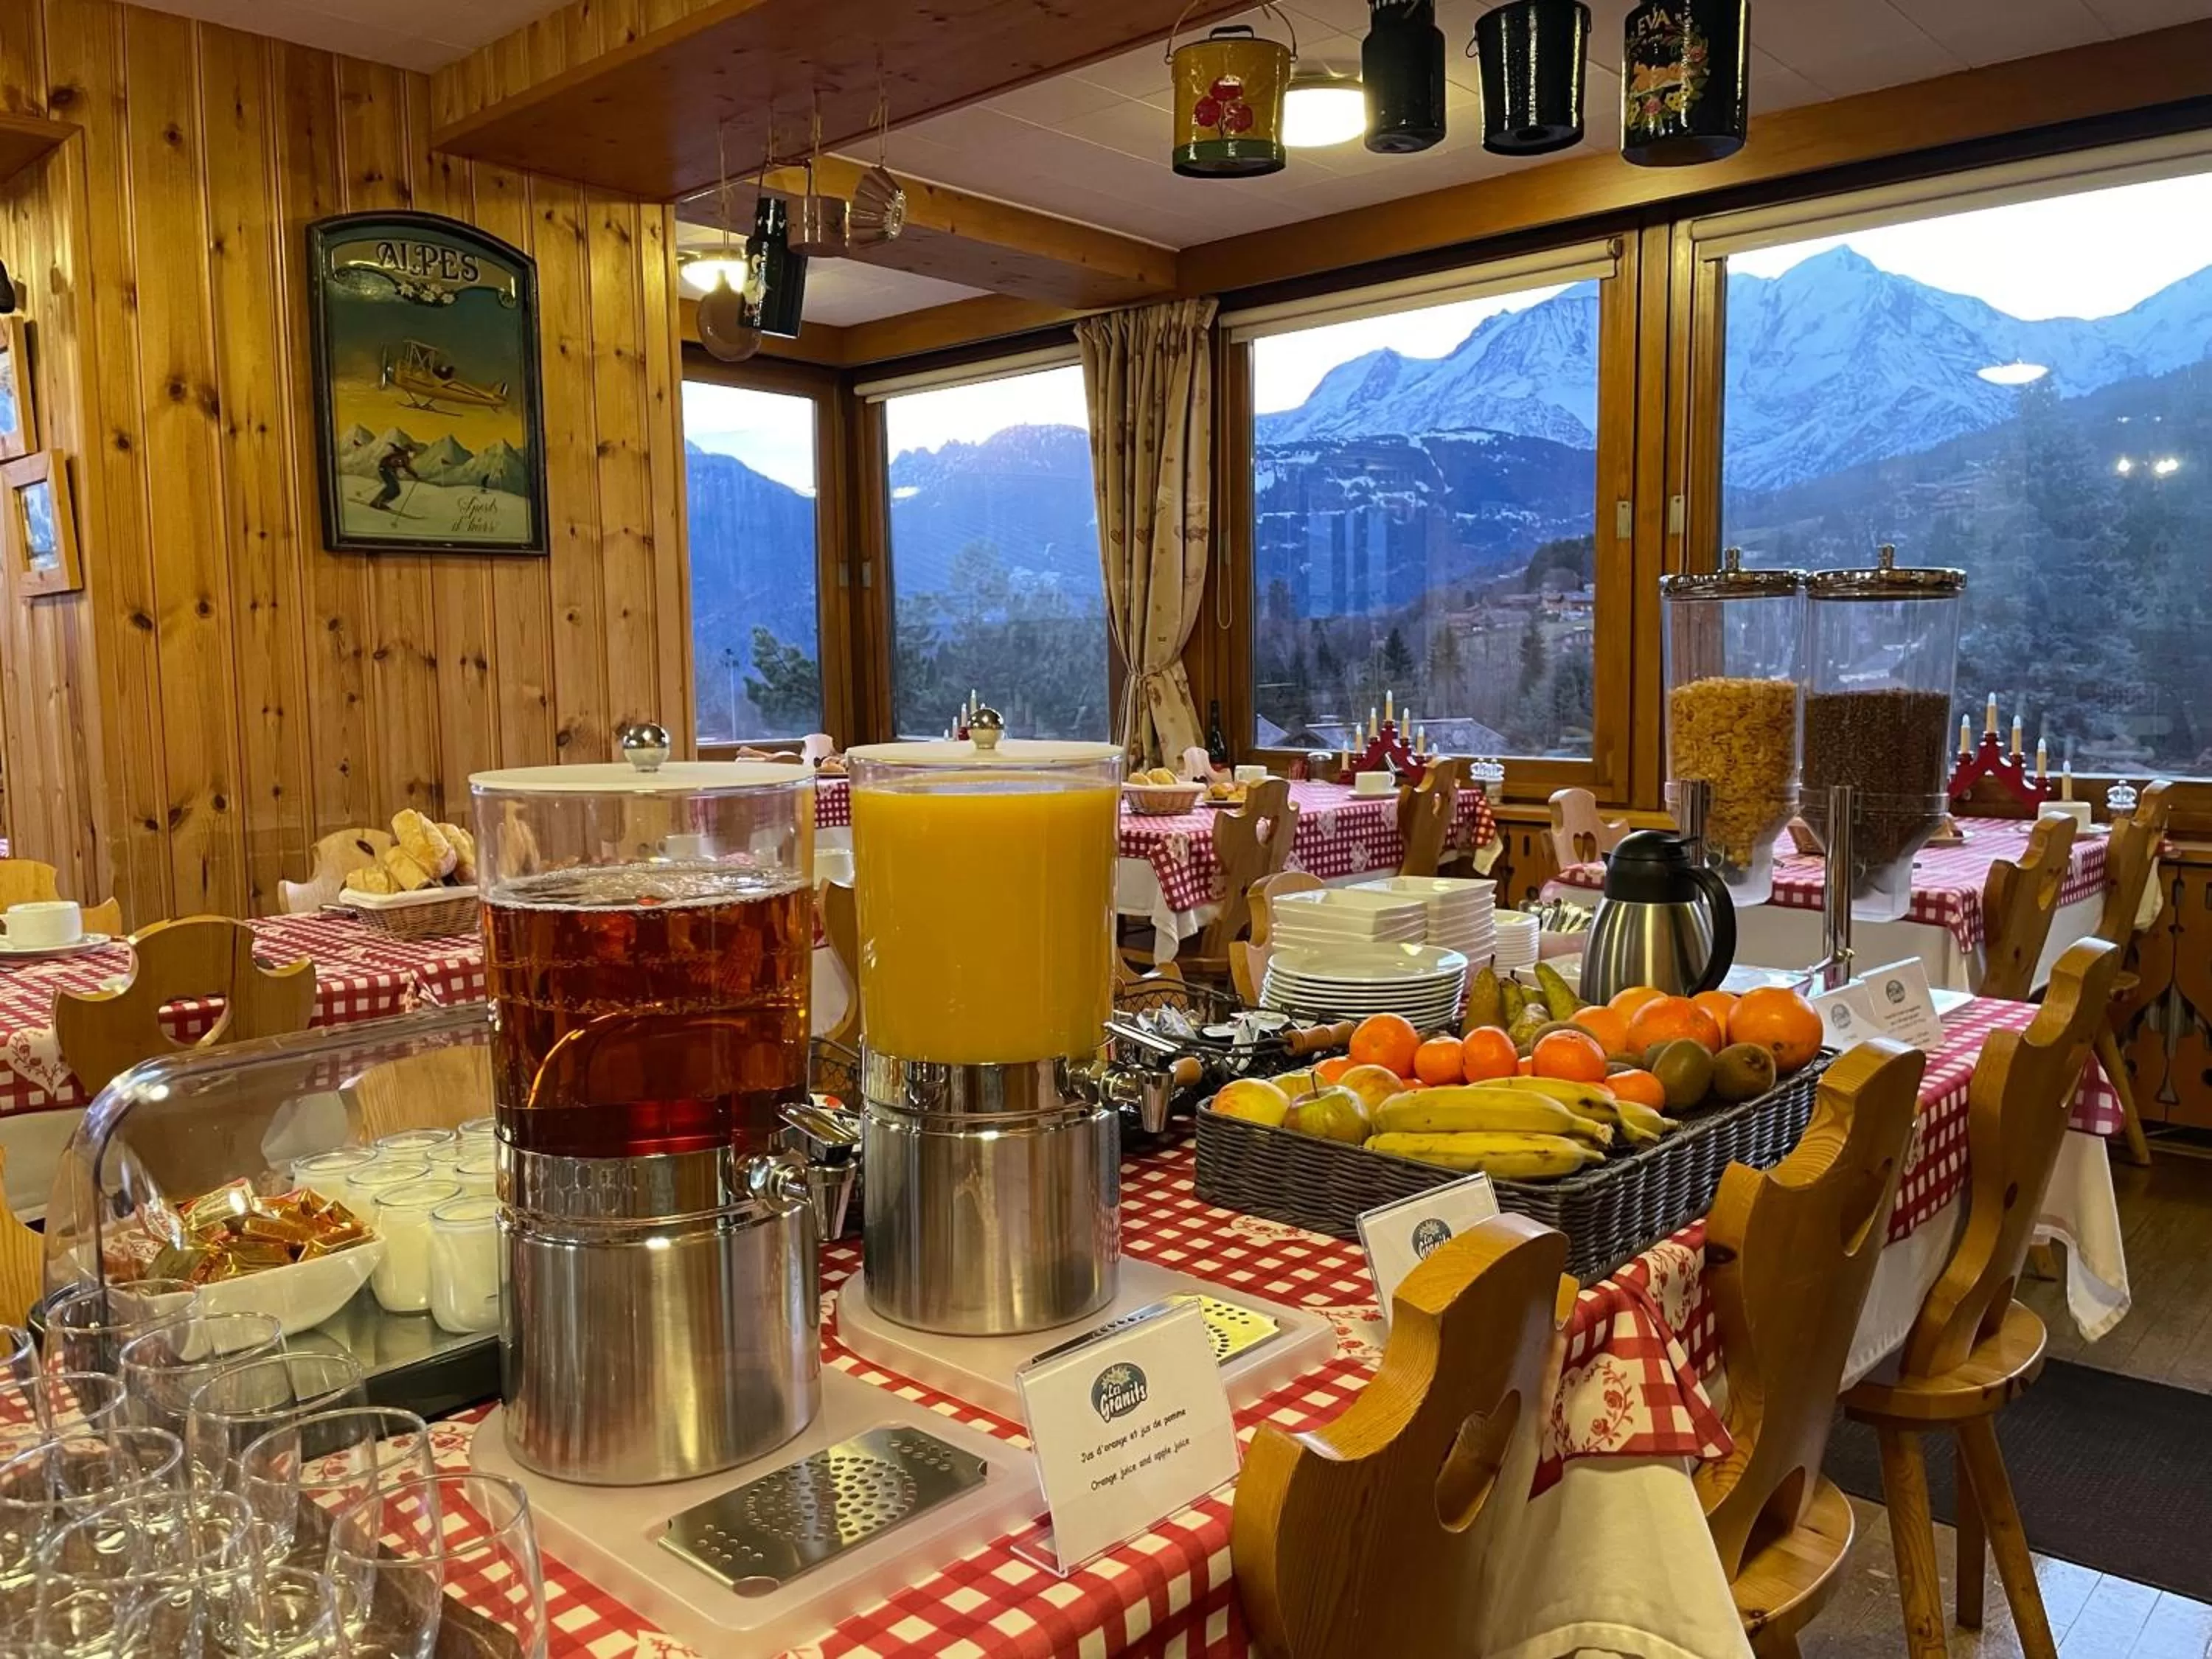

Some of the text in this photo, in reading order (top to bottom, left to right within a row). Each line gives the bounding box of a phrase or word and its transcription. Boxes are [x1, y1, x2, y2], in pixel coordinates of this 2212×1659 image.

[376, 241, 480, 282] ALPES
[1099, 1380, 1148, 1422] Granits
[1107, 1382, 1121, 1398] Les
[1081, 1408, 1186, 1463] Jus d'orange et jus de pomme
[1091, 1438, 1189, 1491] Orange juice and apple juice
